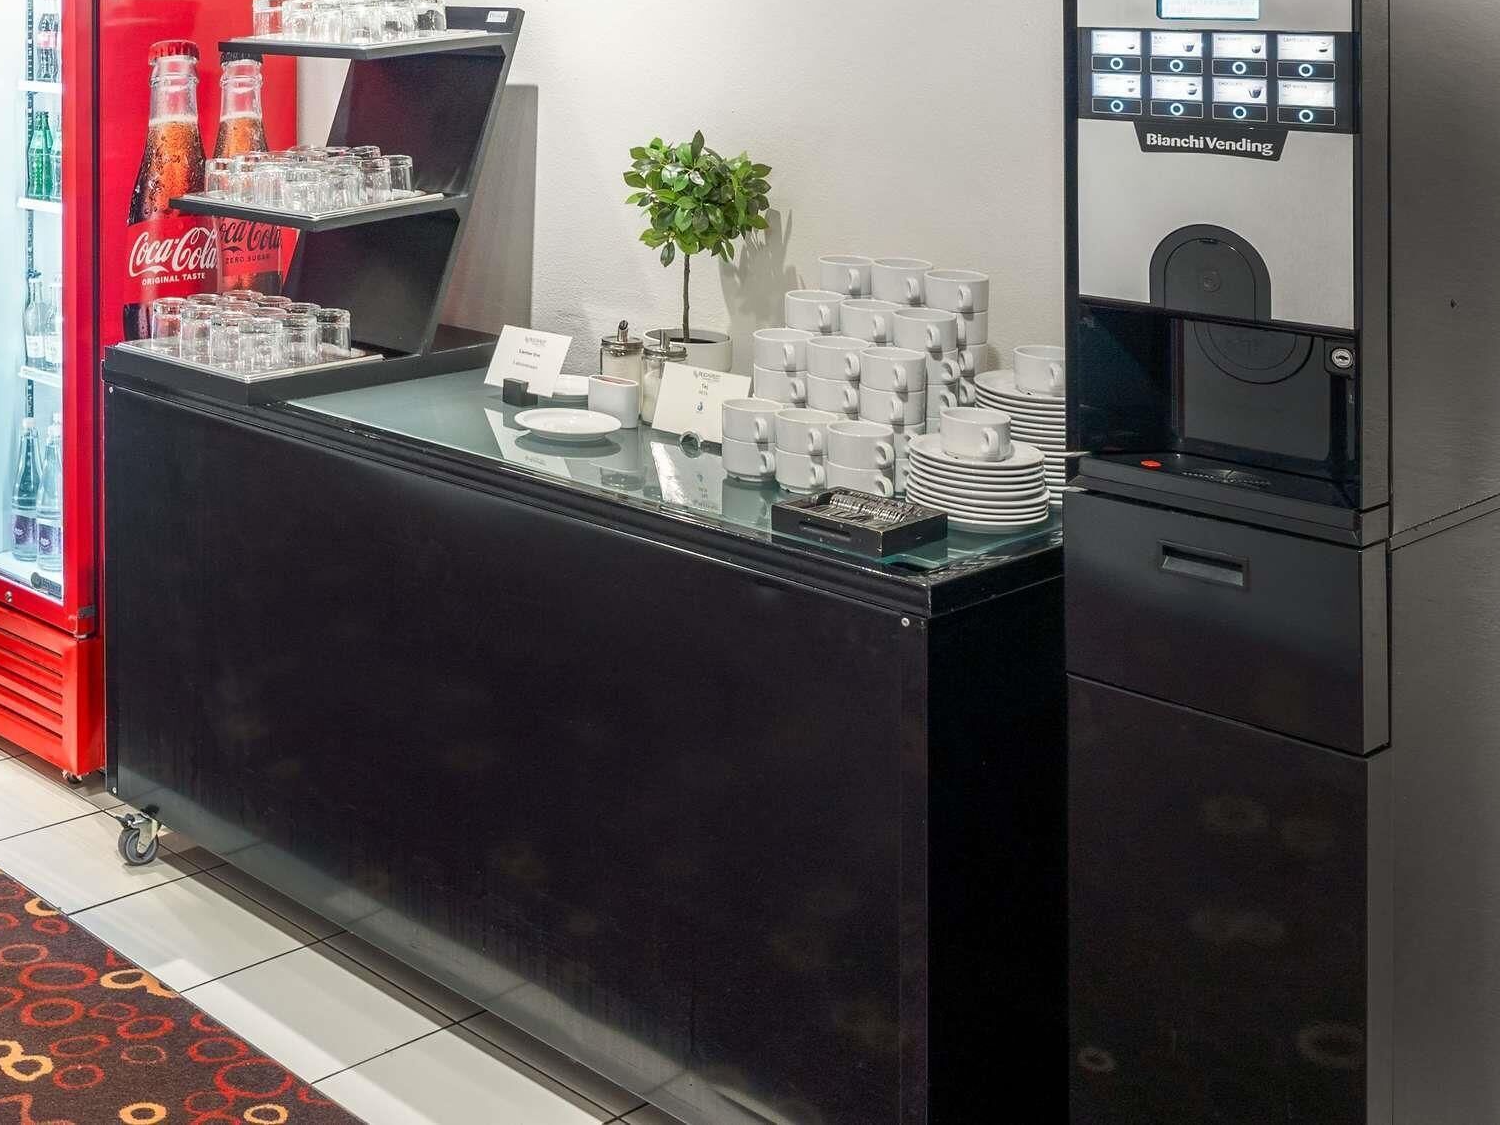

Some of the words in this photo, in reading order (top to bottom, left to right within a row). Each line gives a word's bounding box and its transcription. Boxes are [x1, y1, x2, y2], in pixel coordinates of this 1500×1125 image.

[1146, 133, 1204, 149] Bianchi
[1205, 137, 1274, 157] Vending
[128, 227, 218, 278] Coca-Cola
[226, 257, 245, 265] ZERO
[141, 275, 180, 287] ORIGINAL
[183, 272, 206, 281] TASTE
